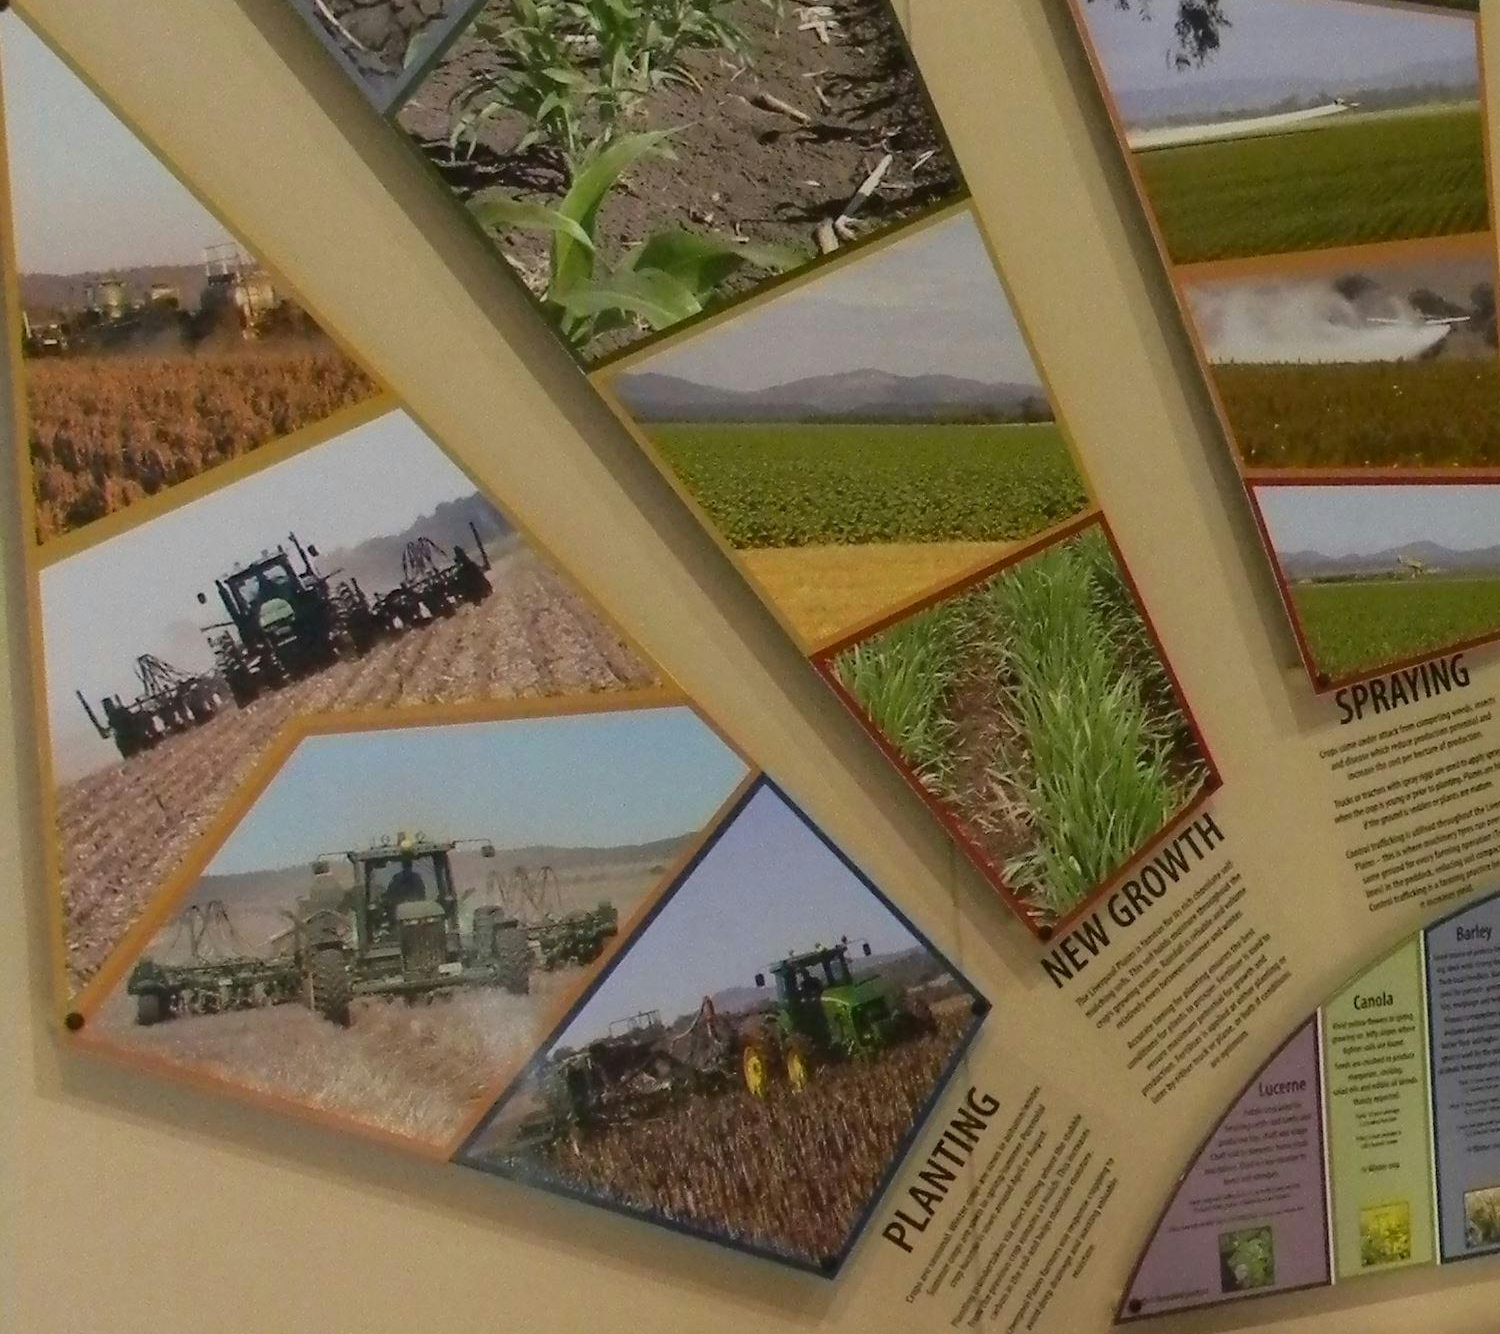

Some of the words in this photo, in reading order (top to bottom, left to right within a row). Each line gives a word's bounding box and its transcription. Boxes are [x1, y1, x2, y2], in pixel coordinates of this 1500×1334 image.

[1335, 653, 1470, 725] SPRAYING
[1040, 917, 1111, 989] NEW
[1107, 812, 1225, 928] GROWTH
[1456, 924, 1492, 942] Barley
[1353, 992, 1394, 1011] Canola
[1259, 1078, 1307, 1097] Lucerne
[882, 1086, 1000, 1253] PLANTING
